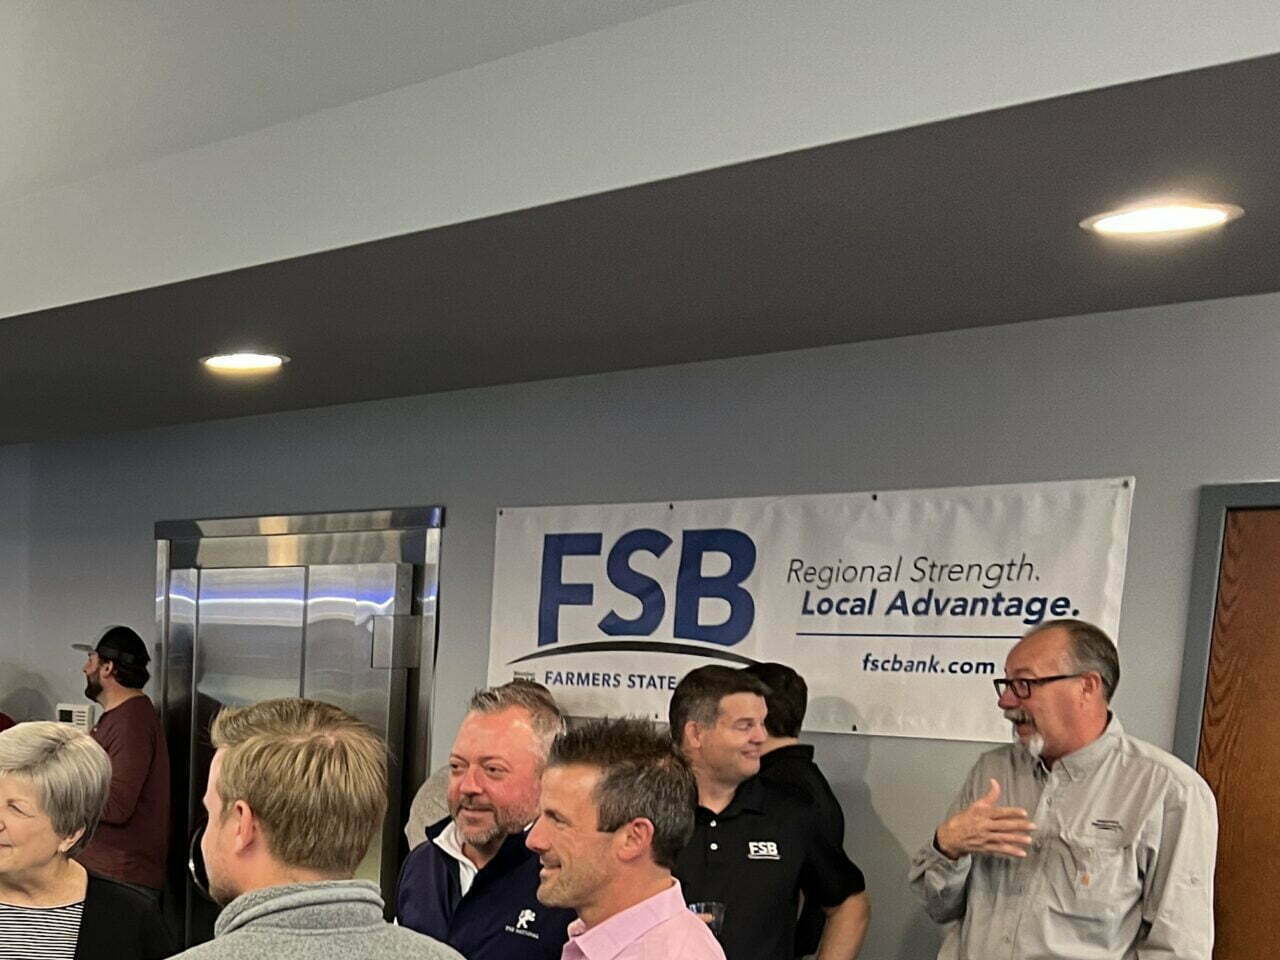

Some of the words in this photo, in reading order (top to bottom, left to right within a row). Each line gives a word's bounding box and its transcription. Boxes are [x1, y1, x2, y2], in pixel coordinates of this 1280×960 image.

[786, 555, 903, 590] Regional
[910, 552, 1040, 589] Strength.
[538, 528, 757, 647] FSB
[801, 588, 877, 615] Local
[884, 588, 1080, 625] Advantage.
[862, 653, 995, 675] fscbank.com
[545, 671, 621, 688] FARMERS
[627, 674, 677, 690] STATE
[748, 842, 778, 856] FSB
